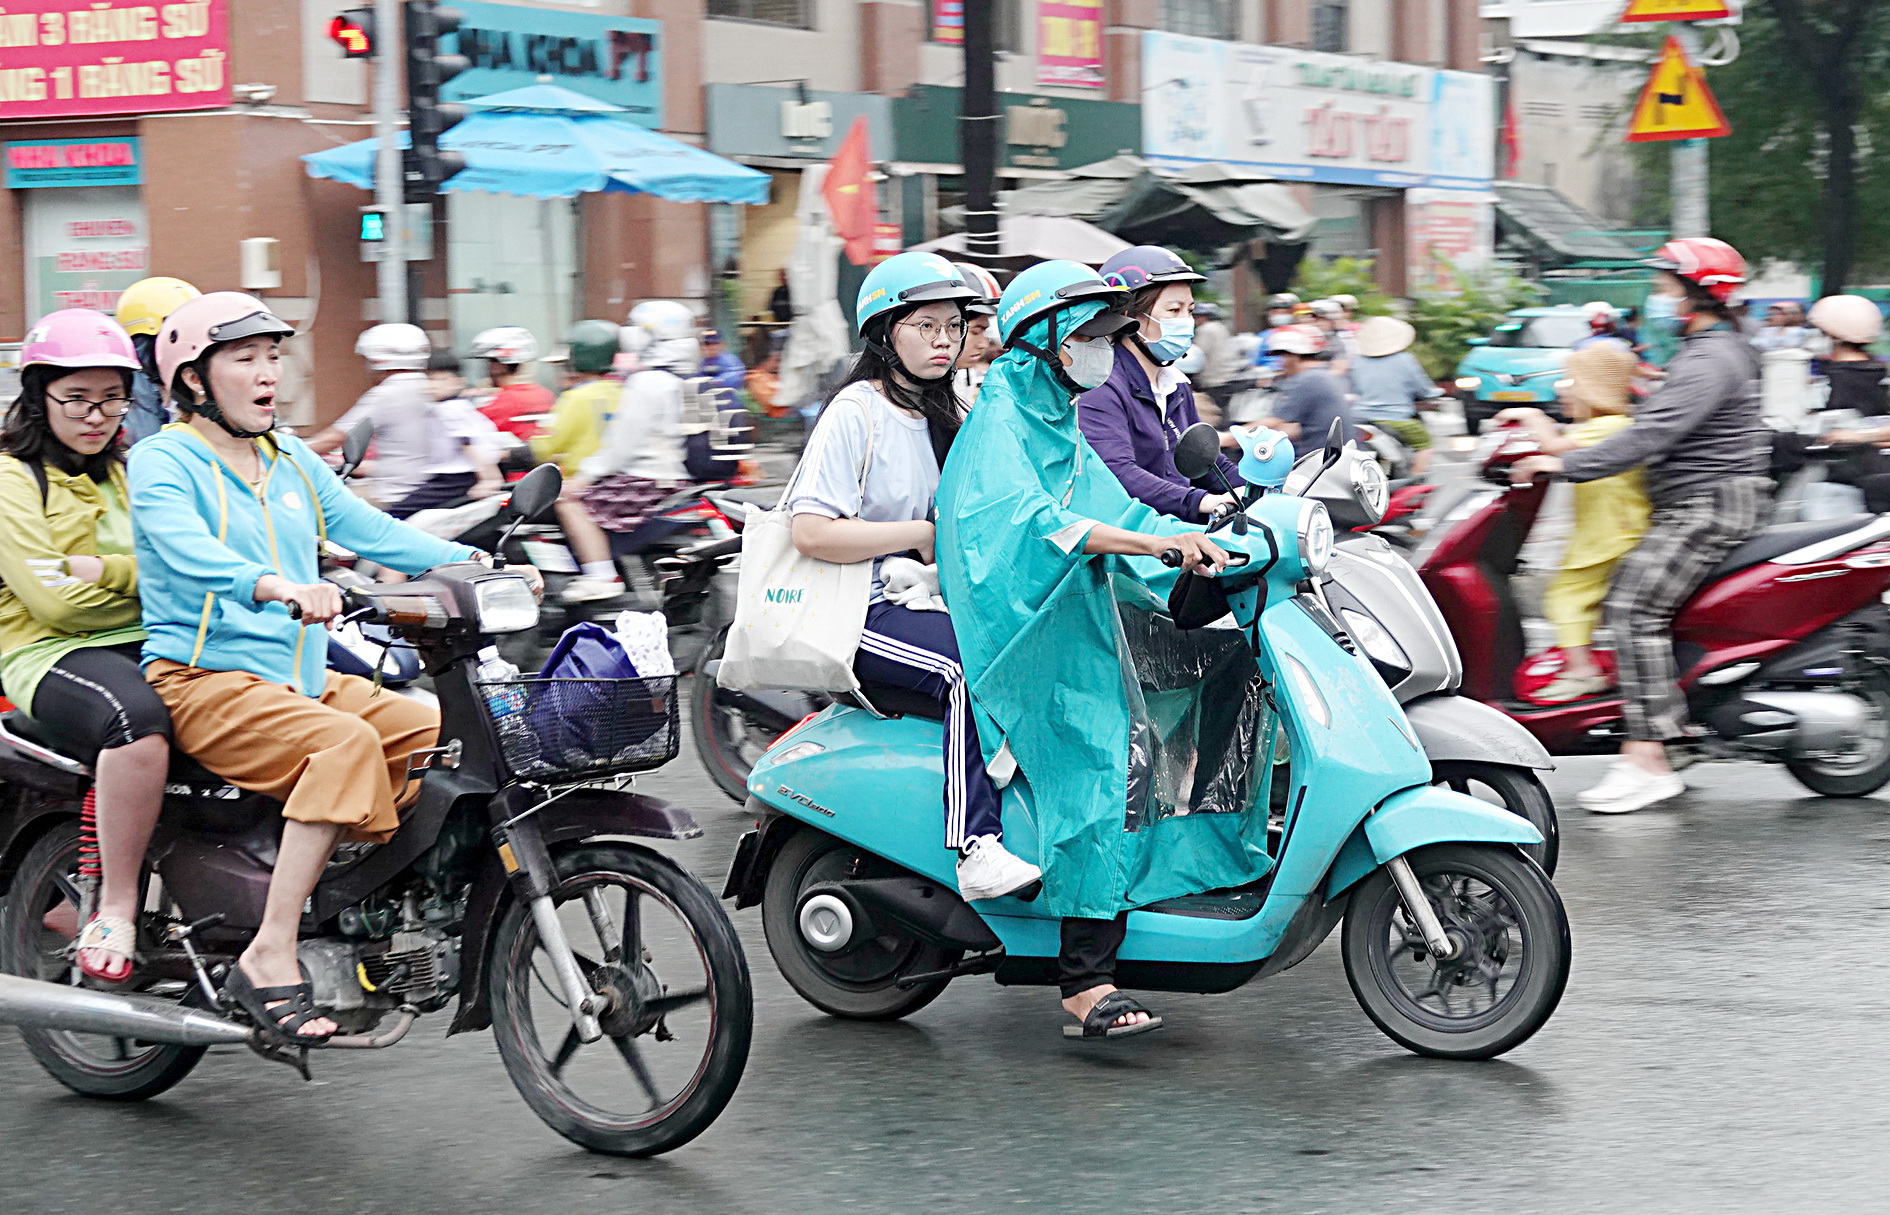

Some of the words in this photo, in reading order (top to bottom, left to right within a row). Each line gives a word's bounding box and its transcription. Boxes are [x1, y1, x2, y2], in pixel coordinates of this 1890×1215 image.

[39, 12, 67, 46] 3
[67, 2, 159, 44] RĂNG
[524, 33, 600, 78] KHOA
[0, 66, 48, 101] NG
[50, 67, 74, 99] 1
[78, 56, 172, 98] RĂNG
[8, 145, 59, 169] NHA
[63, 142, 134, 167] KHOA
[764, 588, 805, 604] NOIRE
